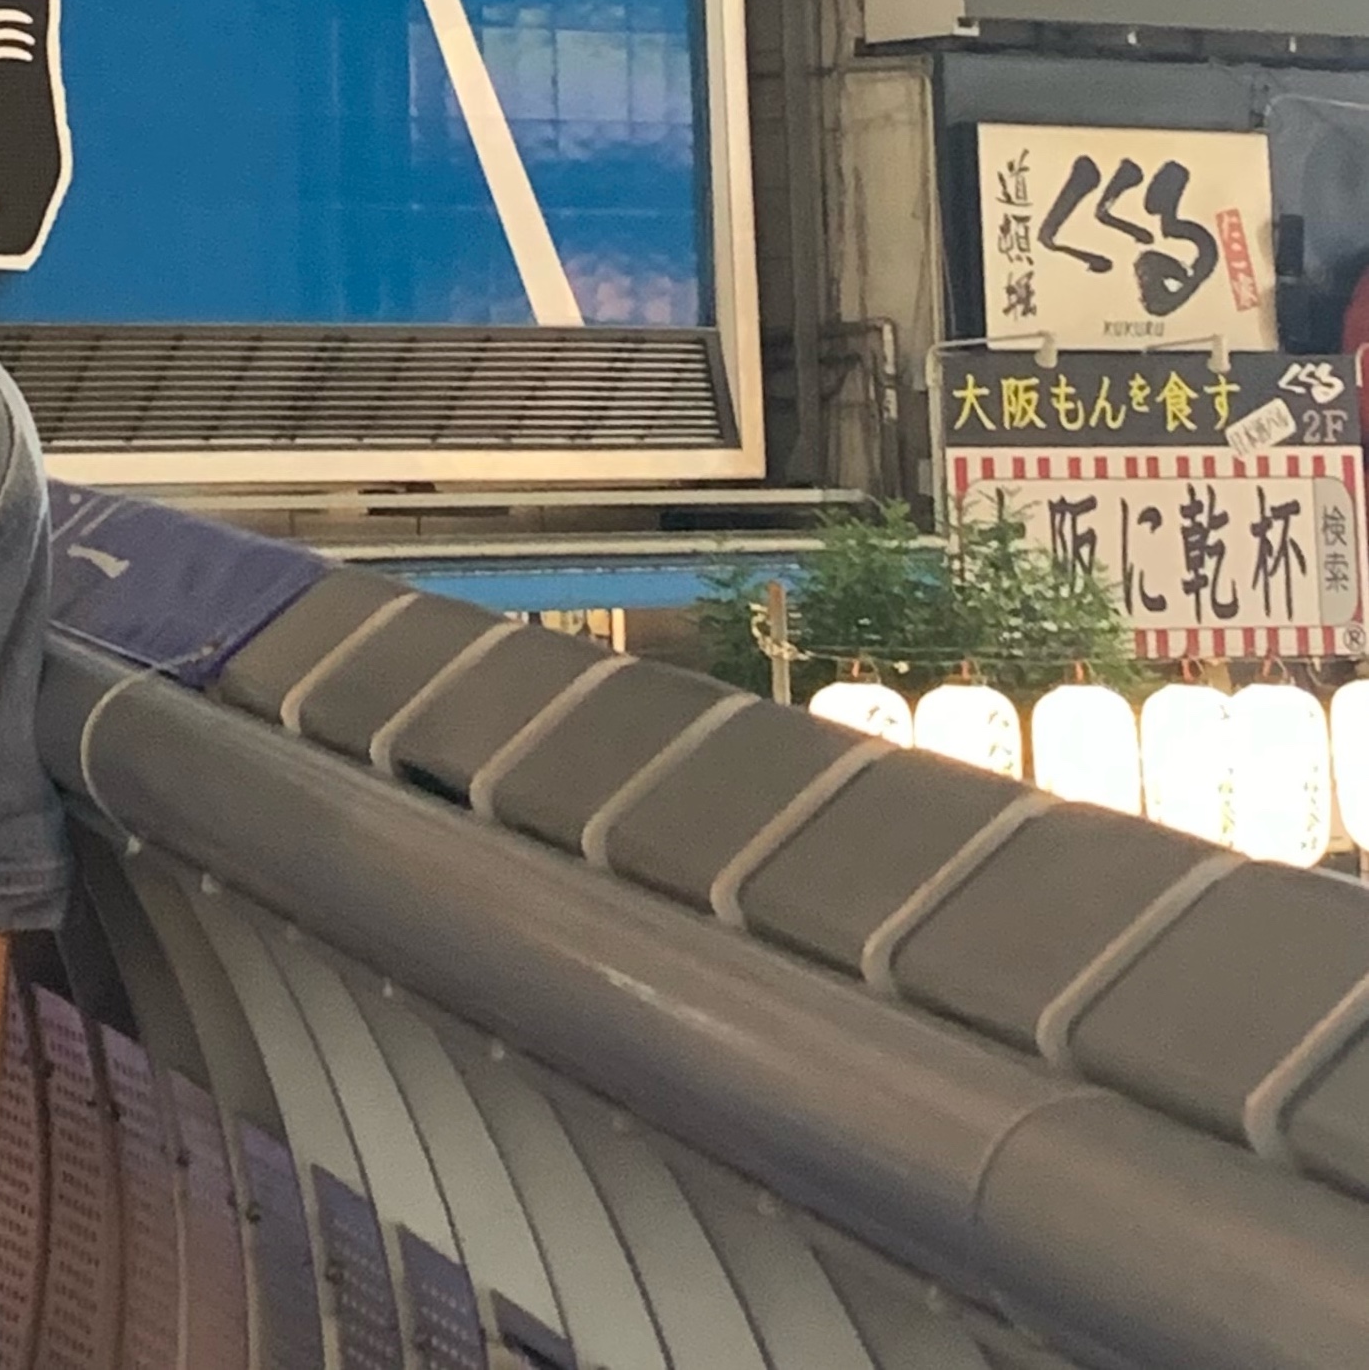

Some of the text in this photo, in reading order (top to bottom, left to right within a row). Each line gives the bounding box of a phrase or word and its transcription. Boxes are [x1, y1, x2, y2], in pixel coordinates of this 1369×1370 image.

[1038, 155, 1219, 317] くくる
[1102, 320, 1165, 338] KUKURU
[953, 371, 1240, 431] 大阪もんを食す
[1302, 409, 1348, 443] 2F
